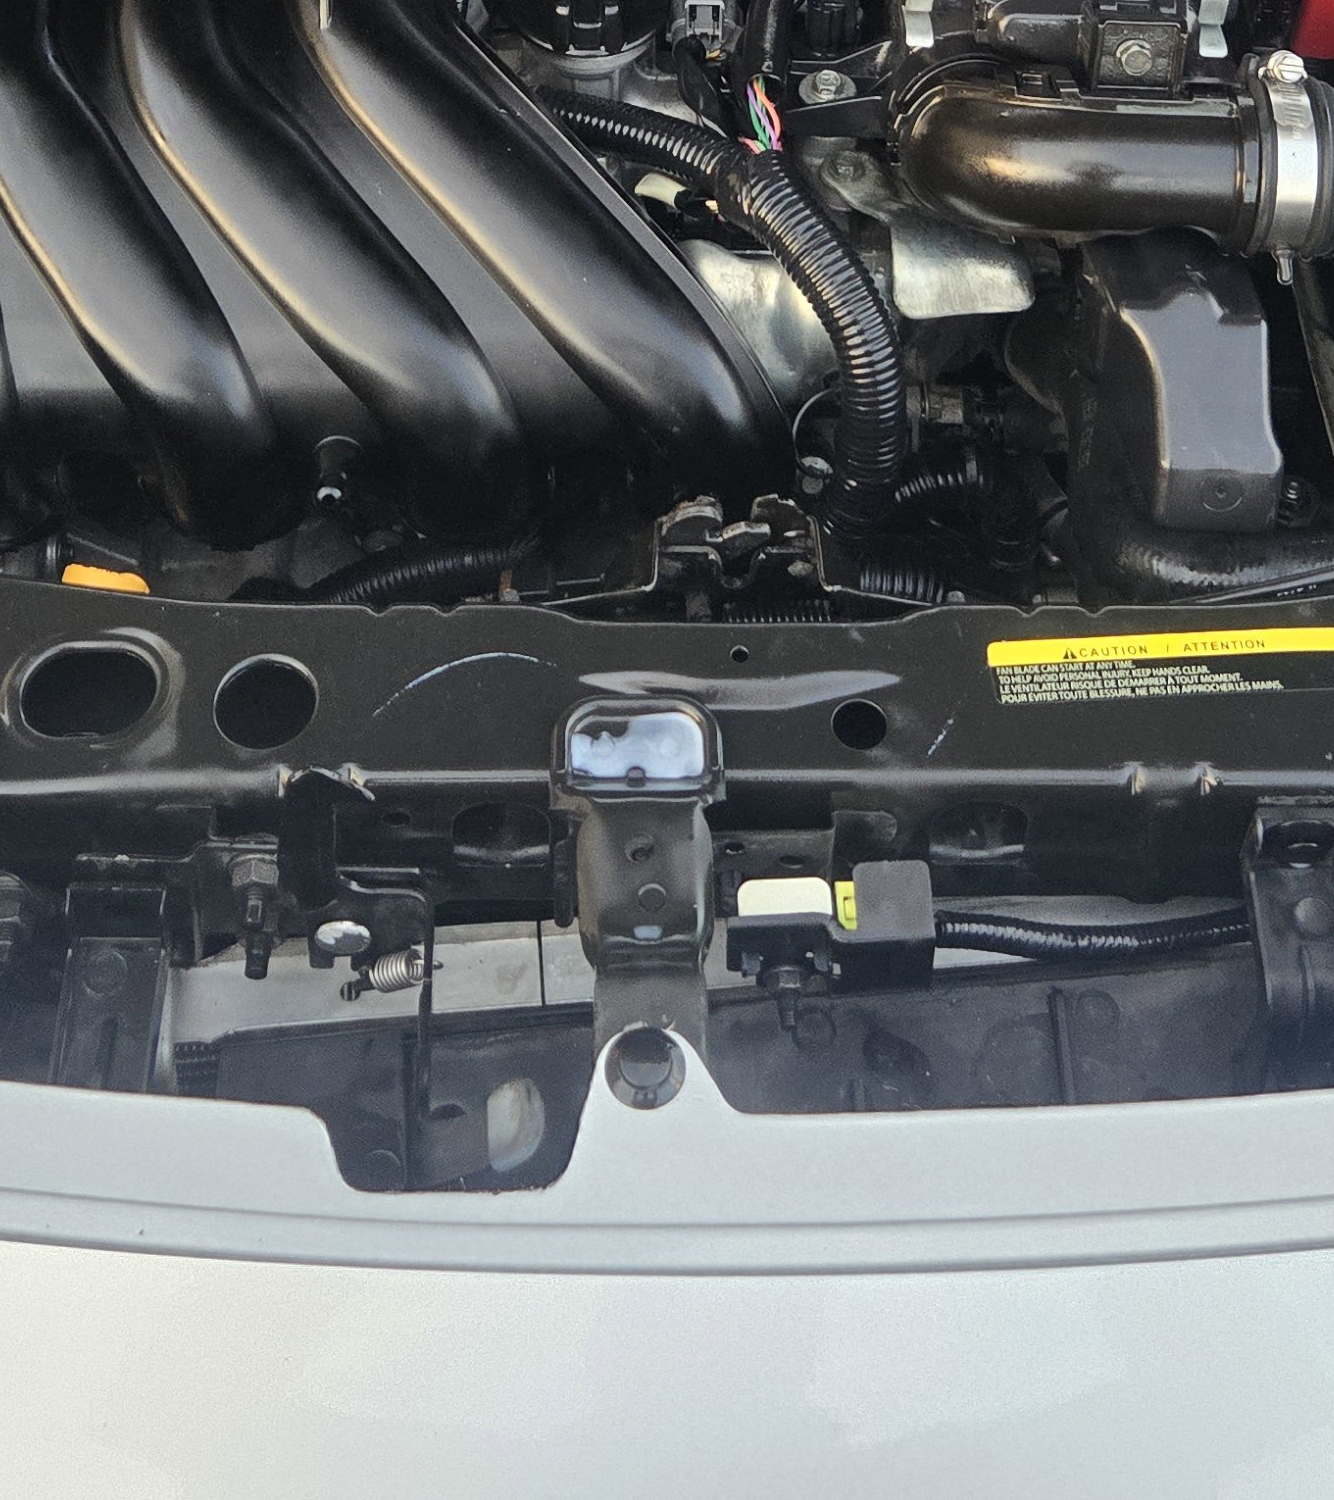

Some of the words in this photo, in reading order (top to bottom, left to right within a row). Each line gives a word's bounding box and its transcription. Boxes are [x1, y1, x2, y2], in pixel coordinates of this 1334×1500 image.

[1079, 645, 1148, 658] CAUTION
[1183, 640, 1266, 652] ATTENTION
[996, 666, 1013, 675] FAN
[1014, 665, 1040, 675] BLADE
[1041, 664, 1059, 673] CAN
[1060, 663, 1085, 672] START
[1085, 662, 1095, 671] AT
[1097, 661, 1113, 670] ANY
[1114, 660, 1136, 669] TIME.
[998, 675, 1010, 684] TO
[1011, 674, 1032, 684] HELP
[1033, 673, 1058, 682] AVOID
[1059, 671, 1101, 681] PERSONAL
[1132, 668, 1151, 677] KEEP
[1153, 666, 1182, 676] HANDS
[1183, 665, 1210, 674] CLEAR.
[1000, 684, 1010, 694] LE
[1011, 682, 1070, 693] VENTILATEUR
[1071, 680, 1102, 690] RISQUE
[1104, 679, 1117, 688] DE
[1176, 674, 1199, 684] TOUT
[1200, 672, 1243, 683] MOMENT.
[1001, 693, 1027, 703] POUR
[1028, 690, 1058, 701] ÉVITER
[1059, 689, 1088, 700] TOUTE
[1089, 687, 1135, 699] BLESSURE,
[1136, 686, 1148, 696] NE
[1150, 686, 1166, 695] PAS
[1168, 685, 1180, 694] EN
[1182, 682, 1235, 693] APPROCHER
[1235, 681, 1251, 691] LES
[1252, 680, 1284, 690] MAINS.
